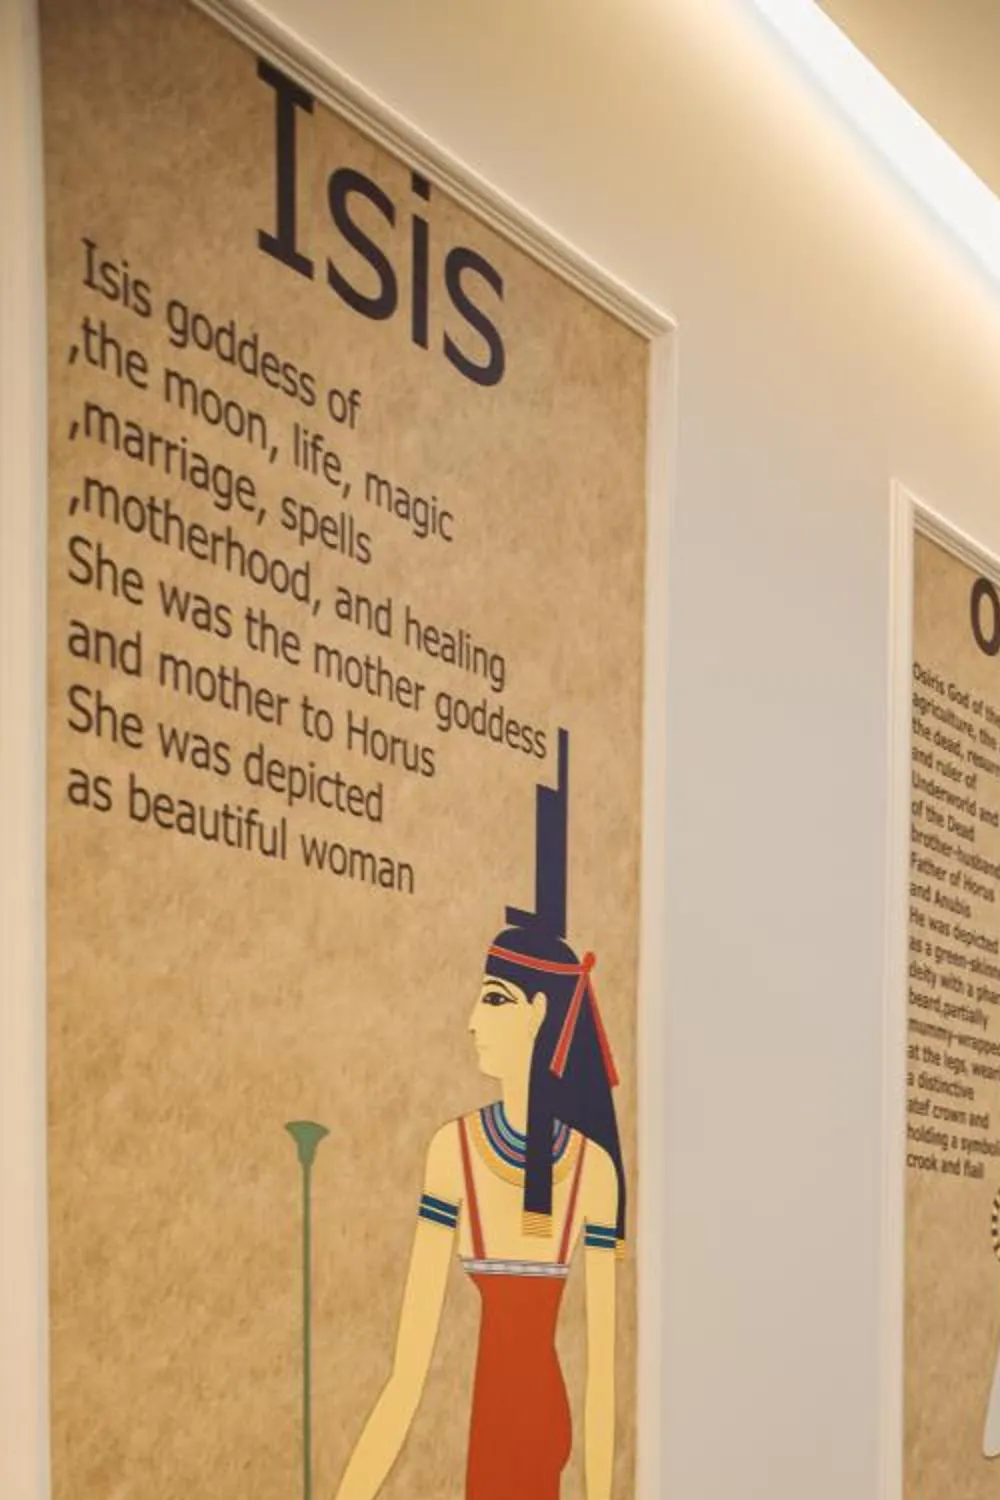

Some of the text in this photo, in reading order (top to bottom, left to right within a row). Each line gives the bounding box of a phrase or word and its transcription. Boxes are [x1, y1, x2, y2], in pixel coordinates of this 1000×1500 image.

[257, 58, 505, 386] Isis
[83, 238, 361, 428] Isis goddess of
[165, 369, 278, 463] moon,
[294, 423, 350, 498] life,
[366, 472, 453, 542] magic
[281, 497, 371, 564] spells
[68, 535, 546, 759] She was the mother goddess
[68, 620, 435, 777] and mother to Horus
[335, 586, 391, 637] and
[405, 606, 505, 693] healing
[68, 684, 383, 822] She was depicted
[68, 768, 414, 893] as beautiful woman
